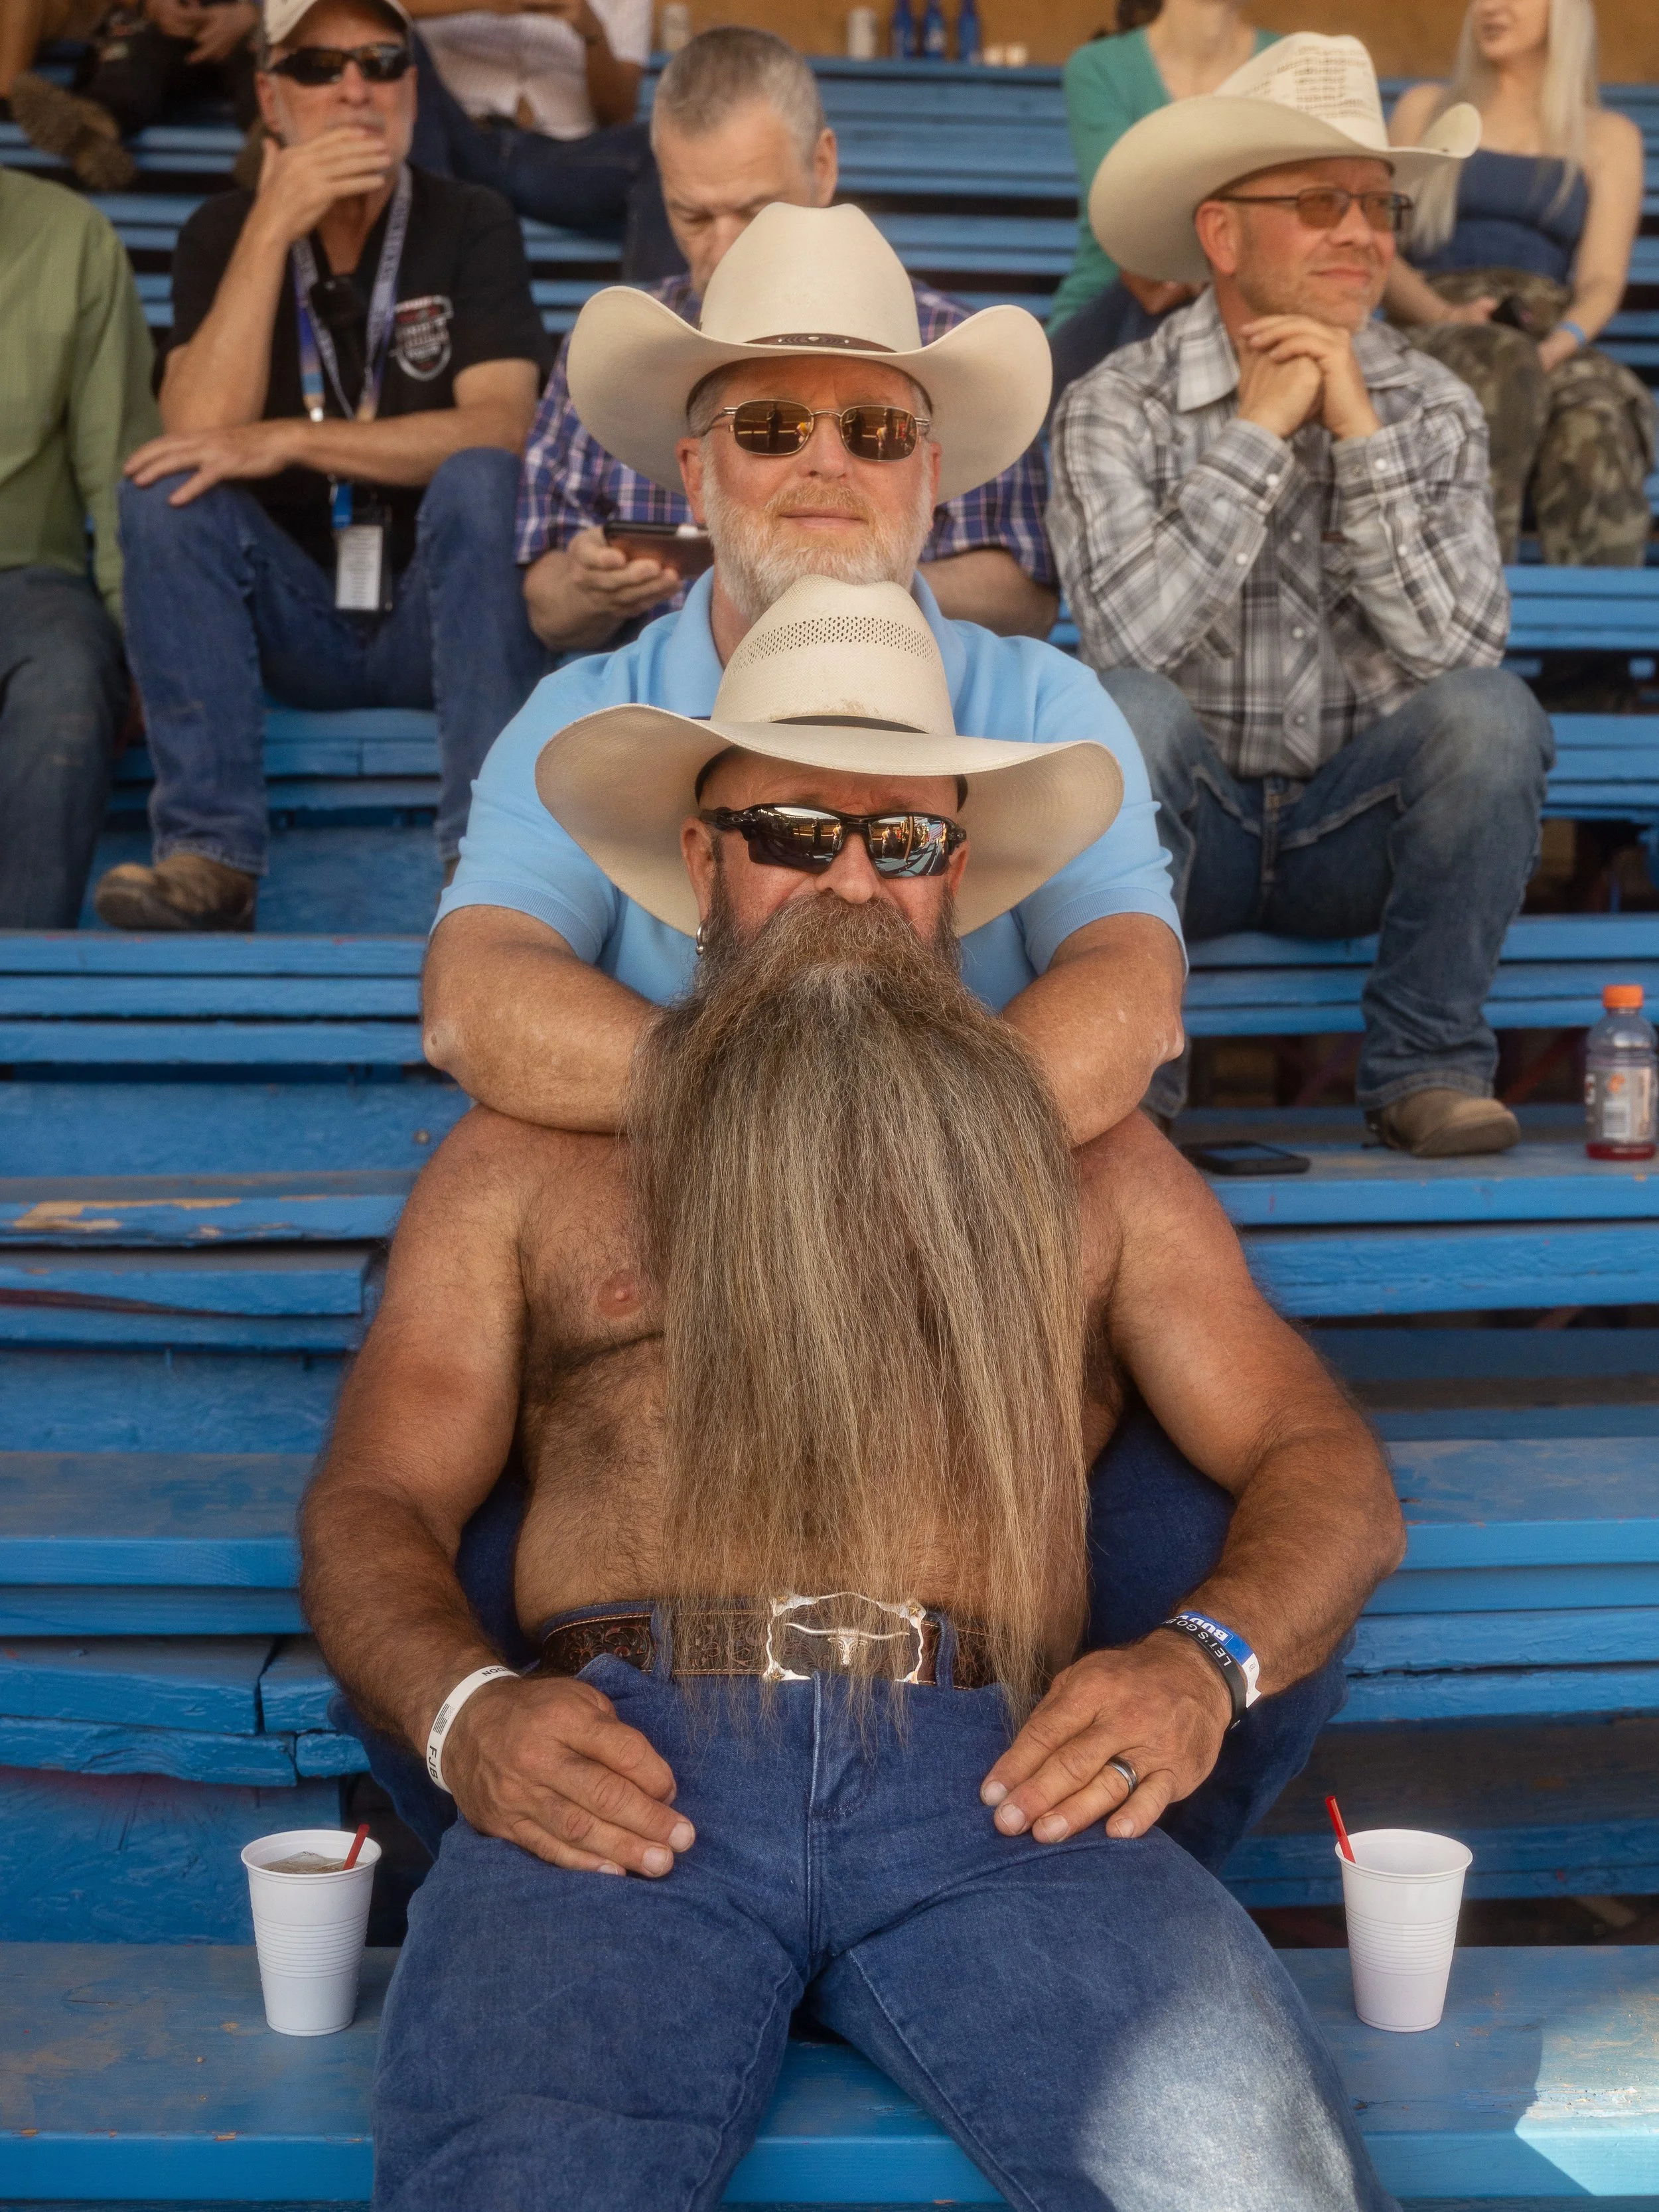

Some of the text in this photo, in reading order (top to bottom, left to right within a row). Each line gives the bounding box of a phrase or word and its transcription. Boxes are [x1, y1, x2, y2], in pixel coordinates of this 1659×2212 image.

[1177, 1620, 1198, 1631] GO
[1198, 1631, 1232, 1667] LET'S
[428, 1745, 439, 1779] FJB
